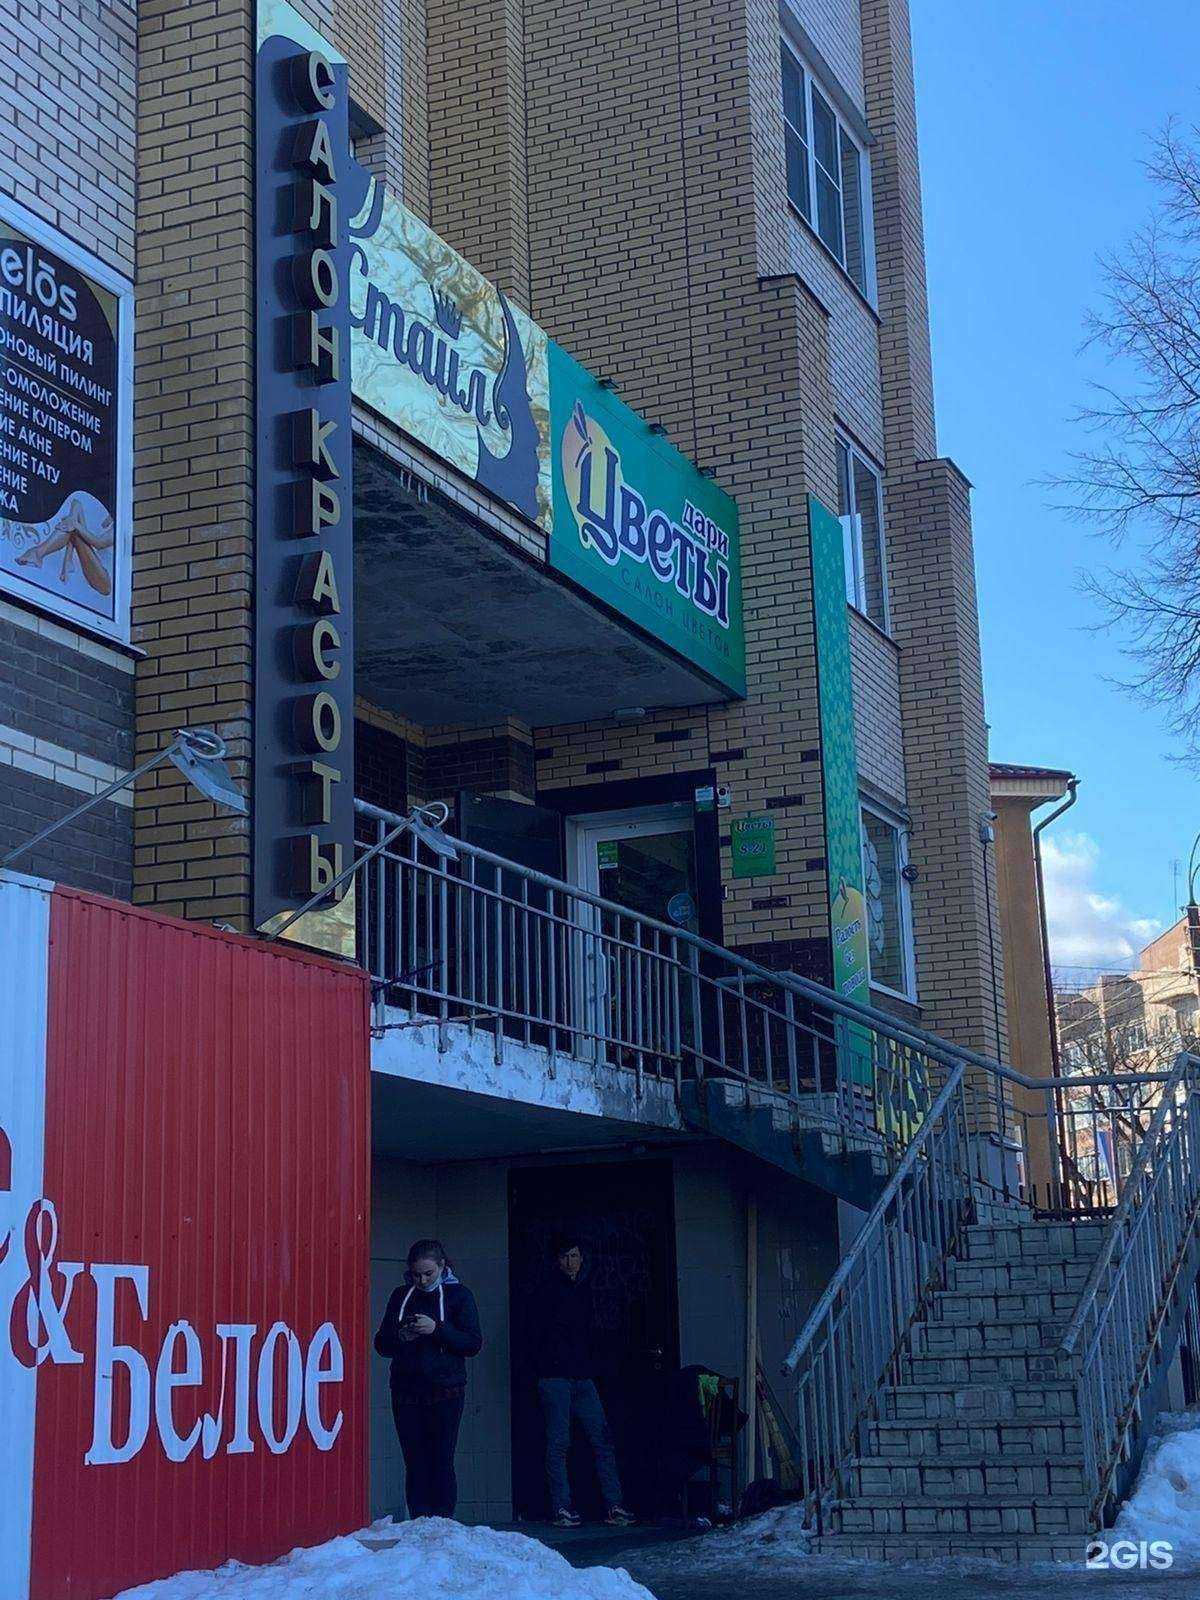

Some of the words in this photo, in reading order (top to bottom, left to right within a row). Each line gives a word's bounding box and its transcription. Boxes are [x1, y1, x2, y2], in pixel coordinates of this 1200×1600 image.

[307, 50, 340, 384] САЛОН
[61, 364, 112, 406] ПИЛИНГ
[19, 426, 52, 456] АКНЕ
[31, 456, 60, 484] ТАТУ
[576, 444, 730, 629] Цветы
[621, 568, 673, 616] САЛОН
[310, 408, 343, 901] КРАСОТЫ
